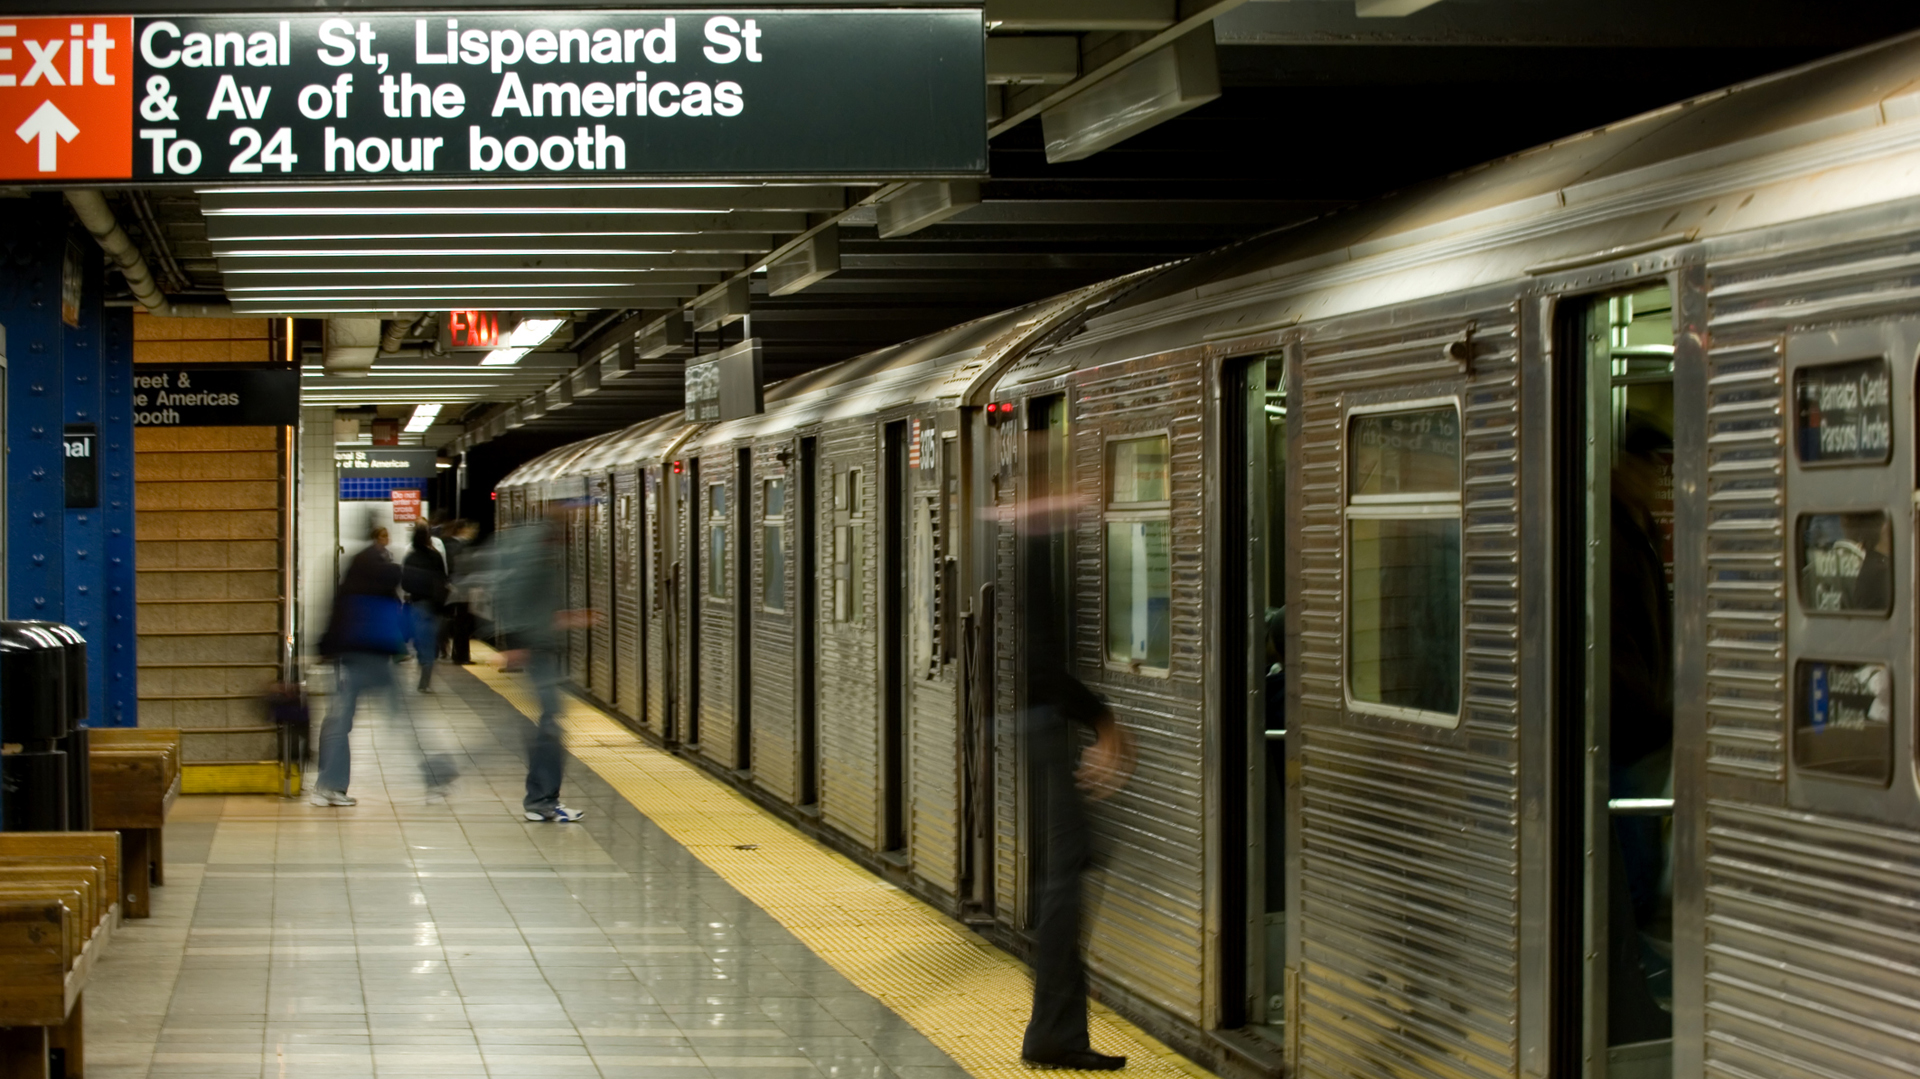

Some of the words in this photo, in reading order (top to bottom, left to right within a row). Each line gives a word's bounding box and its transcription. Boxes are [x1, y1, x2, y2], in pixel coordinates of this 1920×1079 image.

[140, 20, 290, 67] Canal
[317, 19, 389, 73] St,
[416, 18, 677, 74] Lispenard
[703, 17, 762, 64] St
[140, 75, 179, 121] &
[206, 75, 271, 120] Av
[298, 74, 353, 119] of
[379, 73, 465, 118] the
[492, 71, 743, 118] Americas
[140, 129, 202, 175] To
[228, 128, 297, 173] 24
[324, 127, 443, 173] hour
[470, 125, 625, 172] booth
[177, 372, 191, 388] &
[1820, 378, 1858, 412] Jamaica
[156, 390, 240, 406] Americas
[371, 459, 410, 468] Americas
